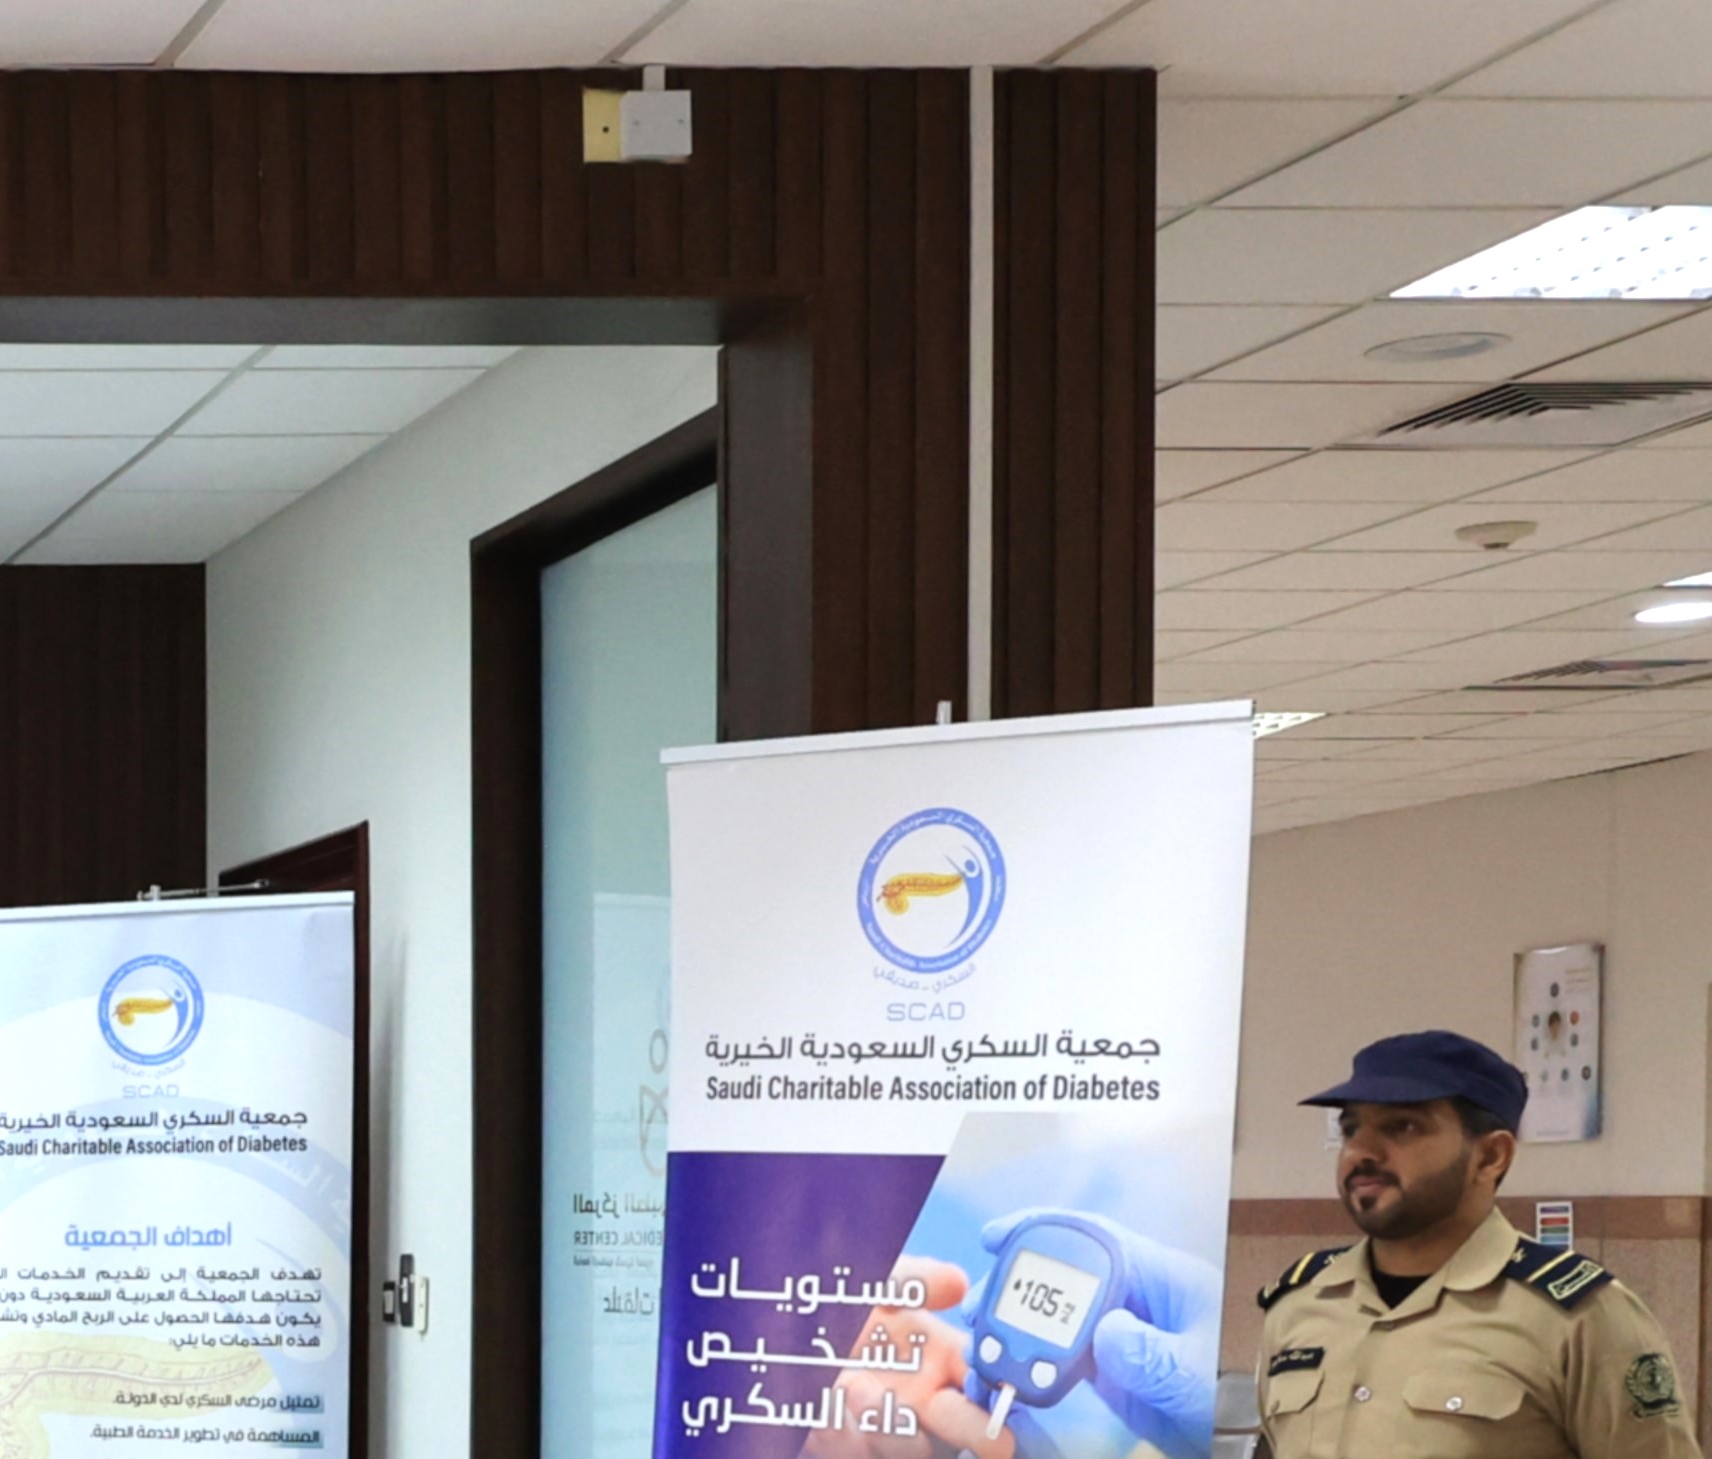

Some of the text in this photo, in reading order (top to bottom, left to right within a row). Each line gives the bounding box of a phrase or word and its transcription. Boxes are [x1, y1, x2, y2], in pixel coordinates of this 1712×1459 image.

[885, 1000, 966, 1022] SCAD
[704, 1028, 1161, 1071] جمعية السكري السعودية الخيرية
[121, 1082, 180, 1100] SCAD
[705, 1072, 1160, 1101] Saudi Charitable Association of Diabetes
[64, 1110, 159, 1132] السعودية
[161, 1108, 235, 1135] السكري
[238, 1109, 308, 1129] جمعية
[41, 1137, 123, 1155] Charitable
[124, 1135, 215, 1155] Association
[217, 1134, 234, 1153] of
[236, 1134, 308, 1153] Diabetes
[63, 1220, 232, 1251] أهداف الجمعية
[16, 1266, 86, 1281] الخدمات
[95, 1266, 150, 1282] تقديم
[159, 1266, 187, 1283] إلى
[195, 1265, 260, 1283] الجمعية
[269, 1267, 322, 1281] تهدف
[689, 1254, 927, 1318] مستويات
[29, 1287, 111, 1304] السعودية
[115, 1287, 175, 1304] العربية
[178, 1287, 246, 1304] المملكة
[250, 1288, 322, 1303] تحتاجها
[1021, 1280, 1064, 1317] 105
[31, 1310, 78, 1327] المادي
[117, 1311, 149, 1325] على
[153, 1310, 209, 1326] الحصول
[212, 1311, 272, 1325] هدفها
[274, 1311, 322, 1328] يكون
[200, 1333, 321, 1348] هذه الخدمات ما
[685, 1318, 927, 1377] تشخيص
[184, 1393, 233, 1409] السكري
[680, 1380, 920, 1440] داء السكري
[135, 1424, 181, 1440] الخدمة
